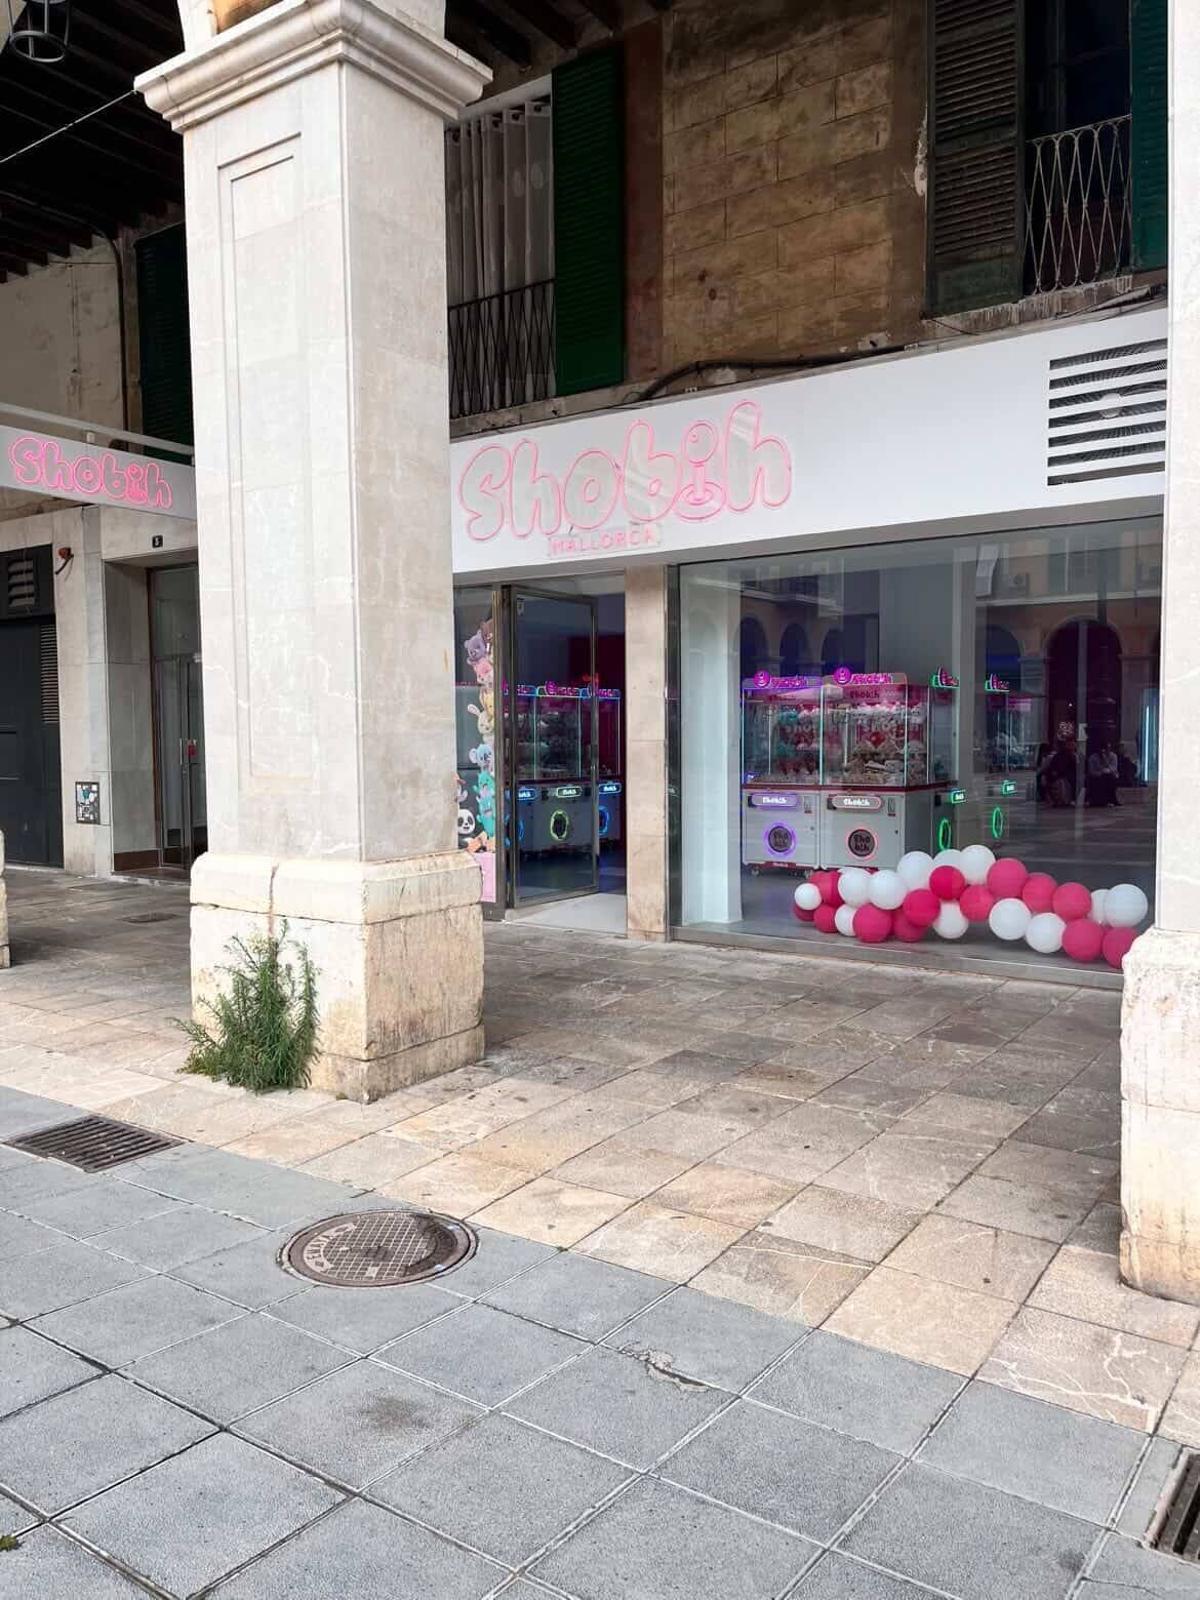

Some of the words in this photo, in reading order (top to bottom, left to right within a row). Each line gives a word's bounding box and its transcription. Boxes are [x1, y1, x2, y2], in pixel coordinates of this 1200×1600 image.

[8, 436, 173, 509] Shobih
[459, 399, 792, 542] Shobih
[550, 524, 656, 556] MALLORCA
